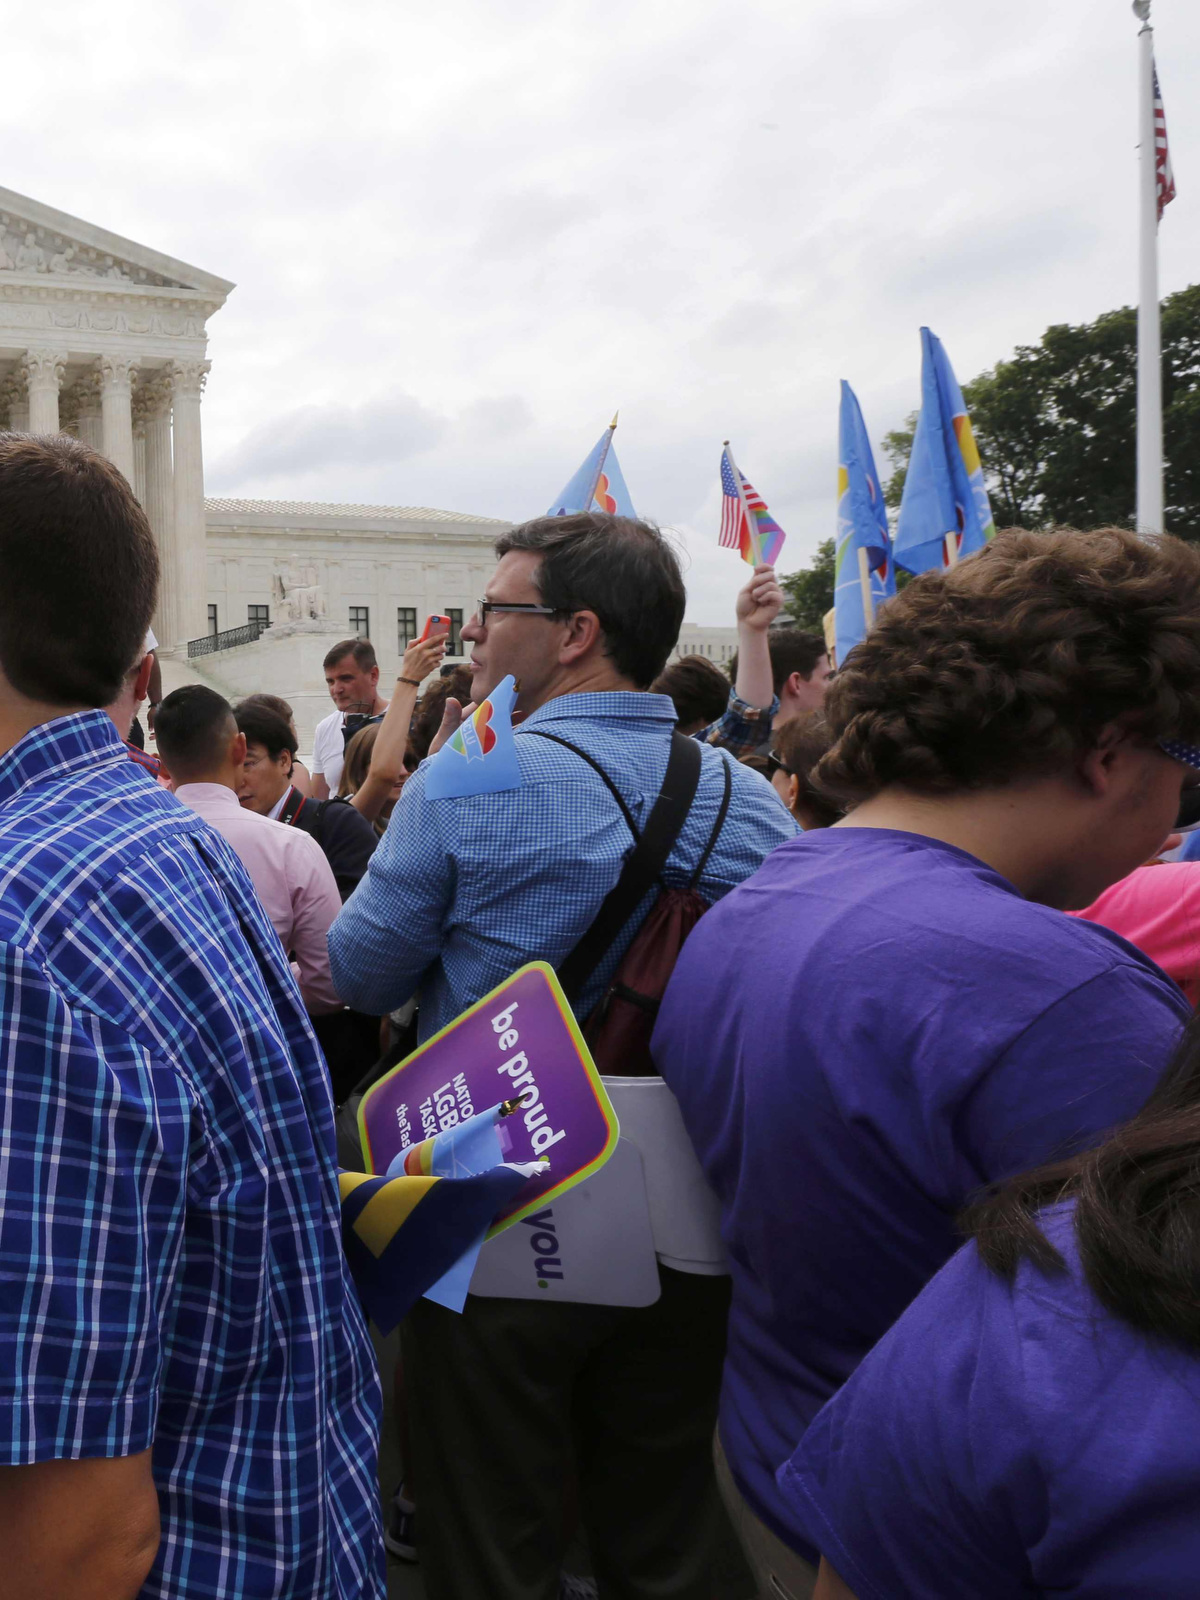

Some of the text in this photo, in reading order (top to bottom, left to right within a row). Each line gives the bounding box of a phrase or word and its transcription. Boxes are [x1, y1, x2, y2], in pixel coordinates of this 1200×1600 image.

[491, 1002, 519, 1051] be
[433, 1082, 460, 1131] LGB
[452, 1072, 476, 1119] NATIO
[396, 1104, 415, 1148] theTas
[520, 1208, 565, 1289] you.
